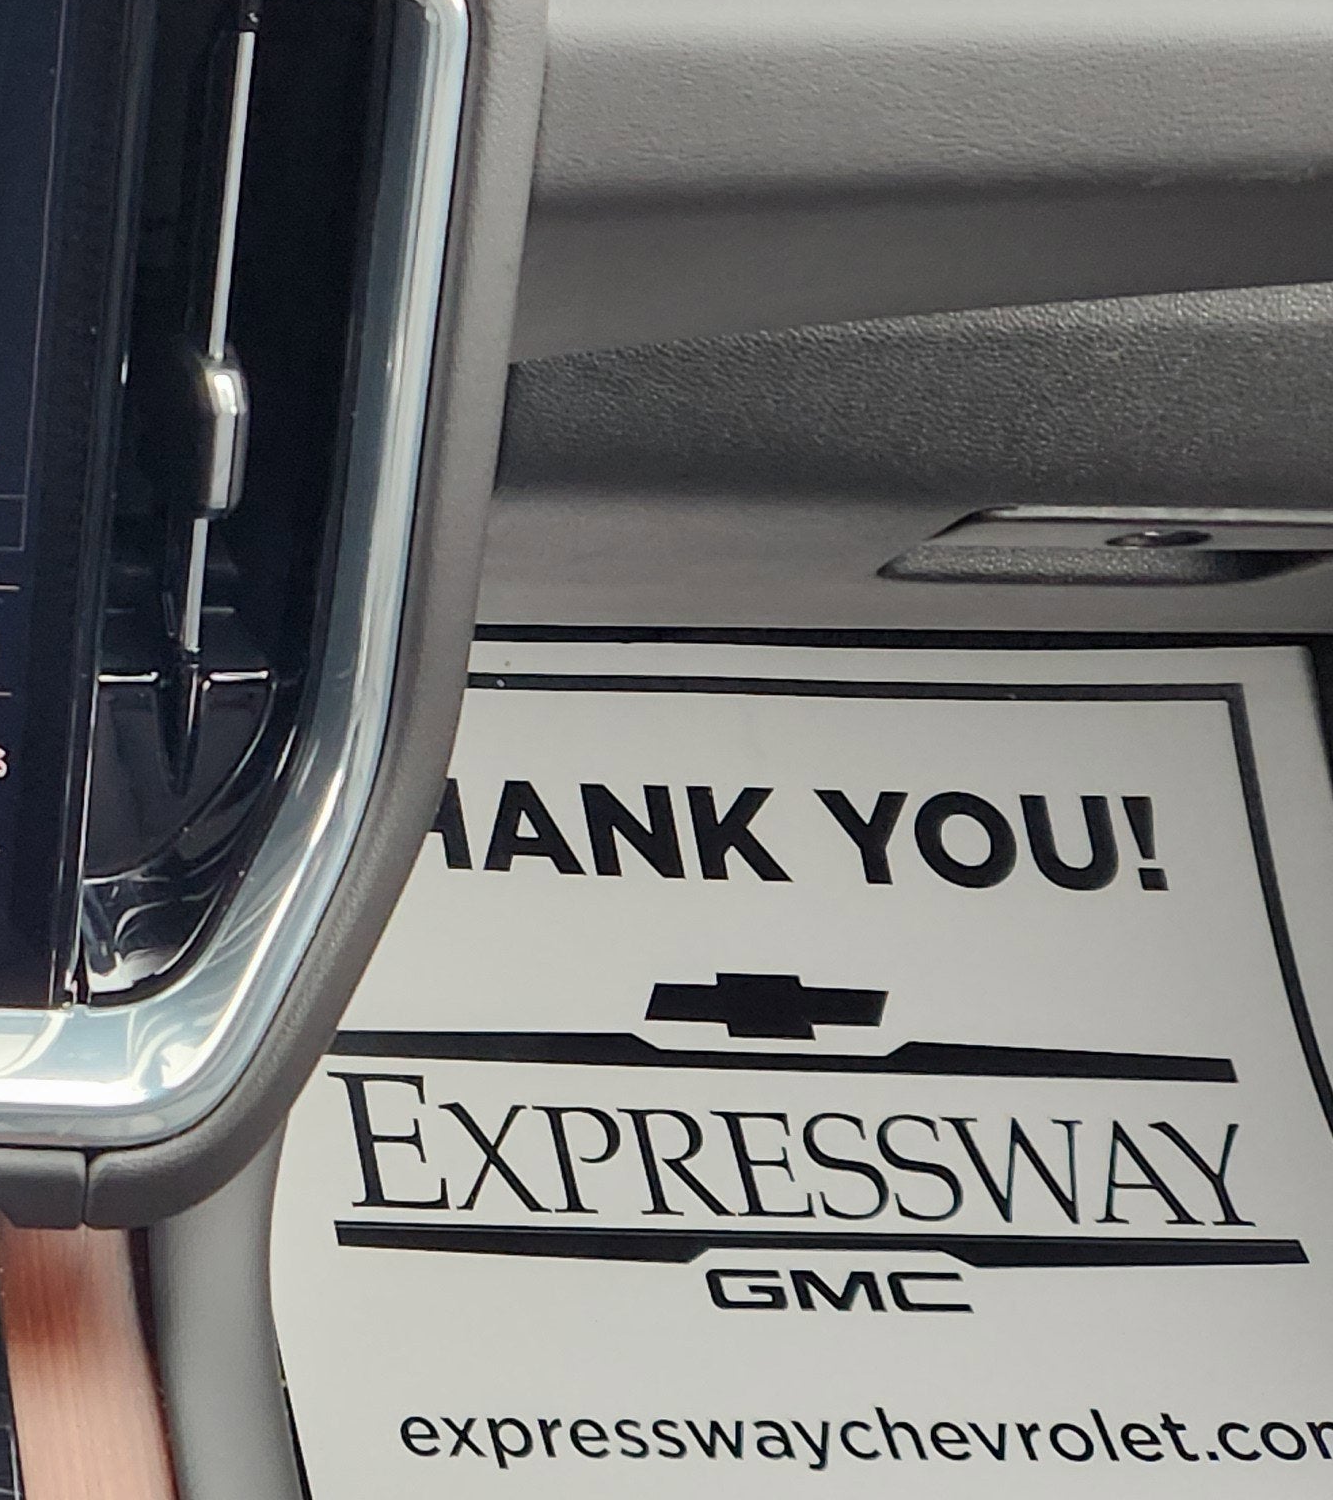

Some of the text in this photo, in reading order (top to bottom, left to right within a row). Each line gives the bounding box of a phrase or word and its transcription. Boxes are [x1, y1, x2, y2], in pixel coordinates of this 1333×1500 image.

[813, 788, 1169, 891] YOU!
[327, 1070, 1256, 1228] EXPRESSWAY
[705, 1268, 975, 1314] GMC
